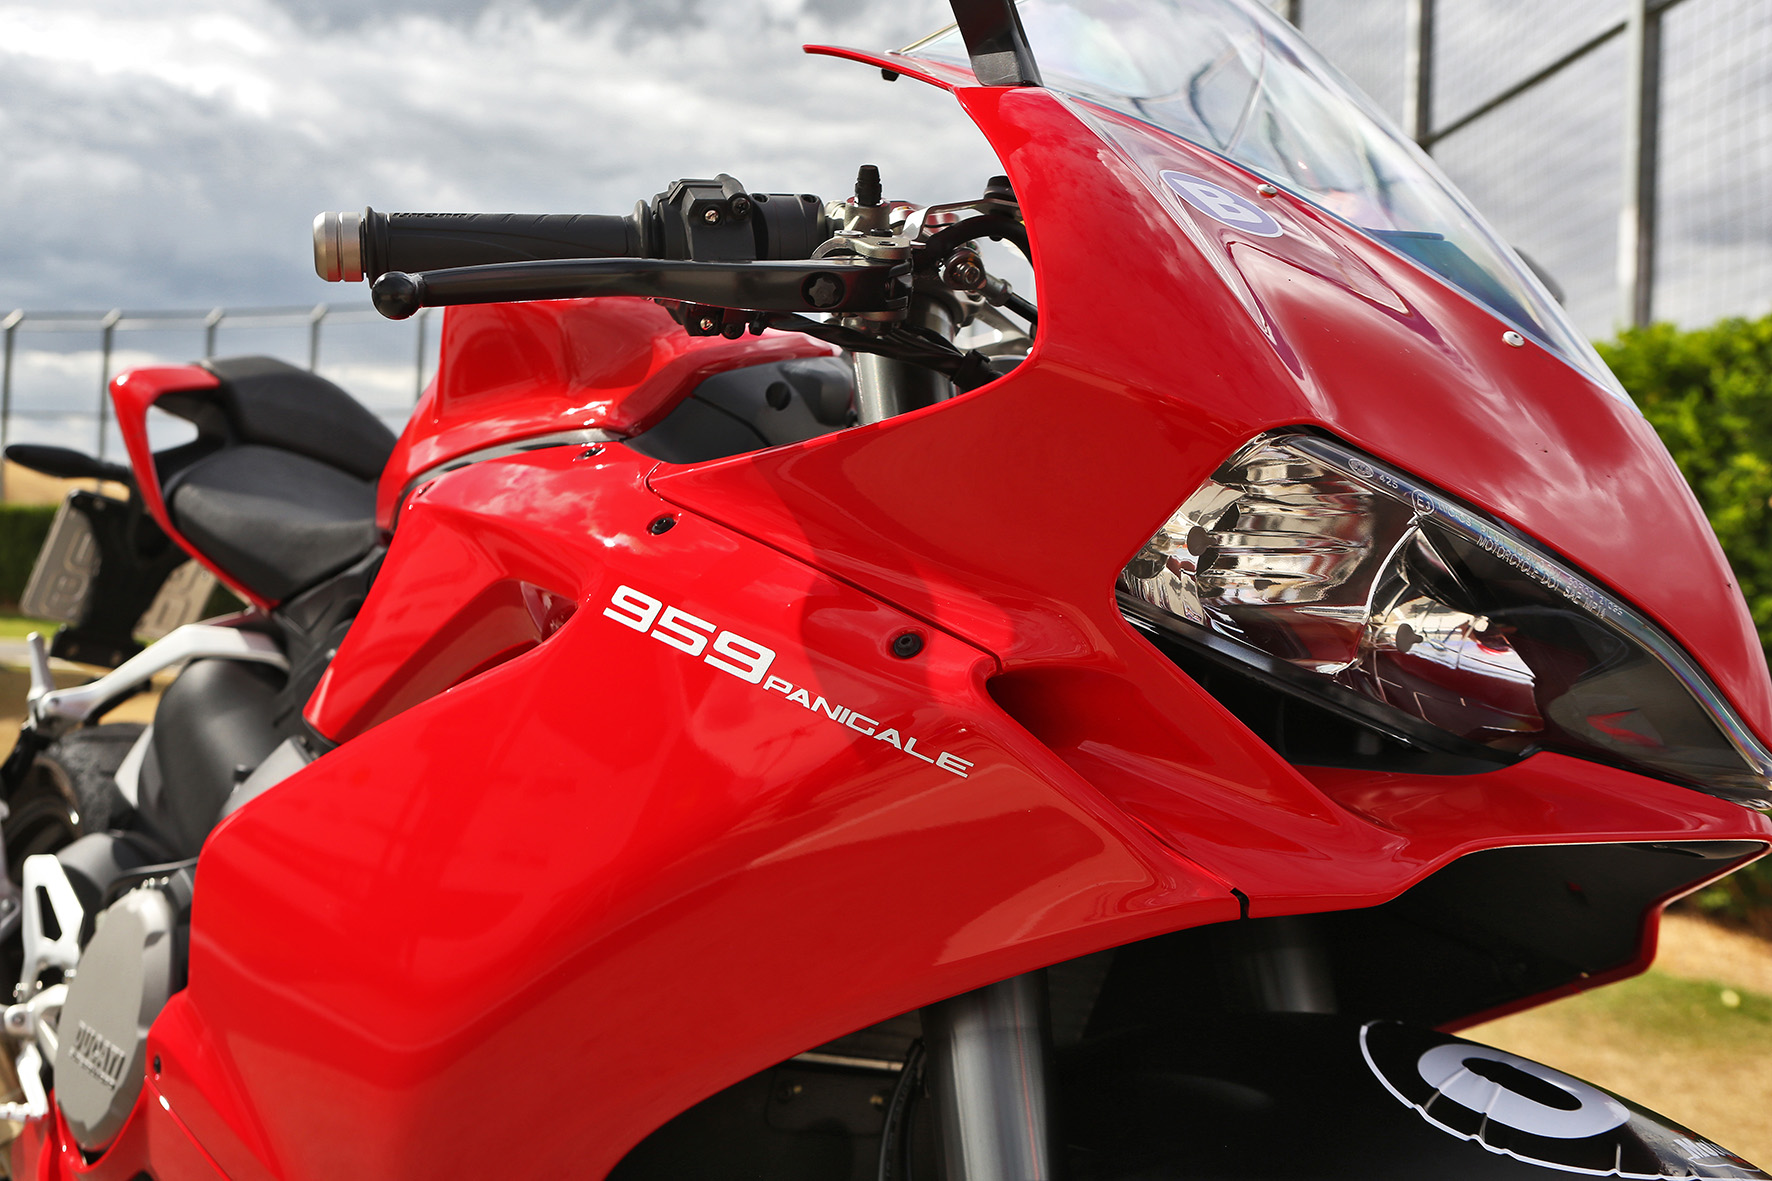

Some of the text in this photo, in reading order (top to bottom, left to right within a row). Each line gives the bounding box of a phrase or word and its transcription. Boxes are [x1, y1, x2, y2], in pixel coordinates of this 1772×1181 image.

[1171, 178, 1263, 224] B
[1476, 534, 1537, 580] MOTORCYCLE
[1540, 571, 1562, 592] DOT
[1563, 585, 1582, 605] SAE
[603, 584, 974, 779] 959 PANIGALE
[76, 1019, 126, 1080] DUCATI
